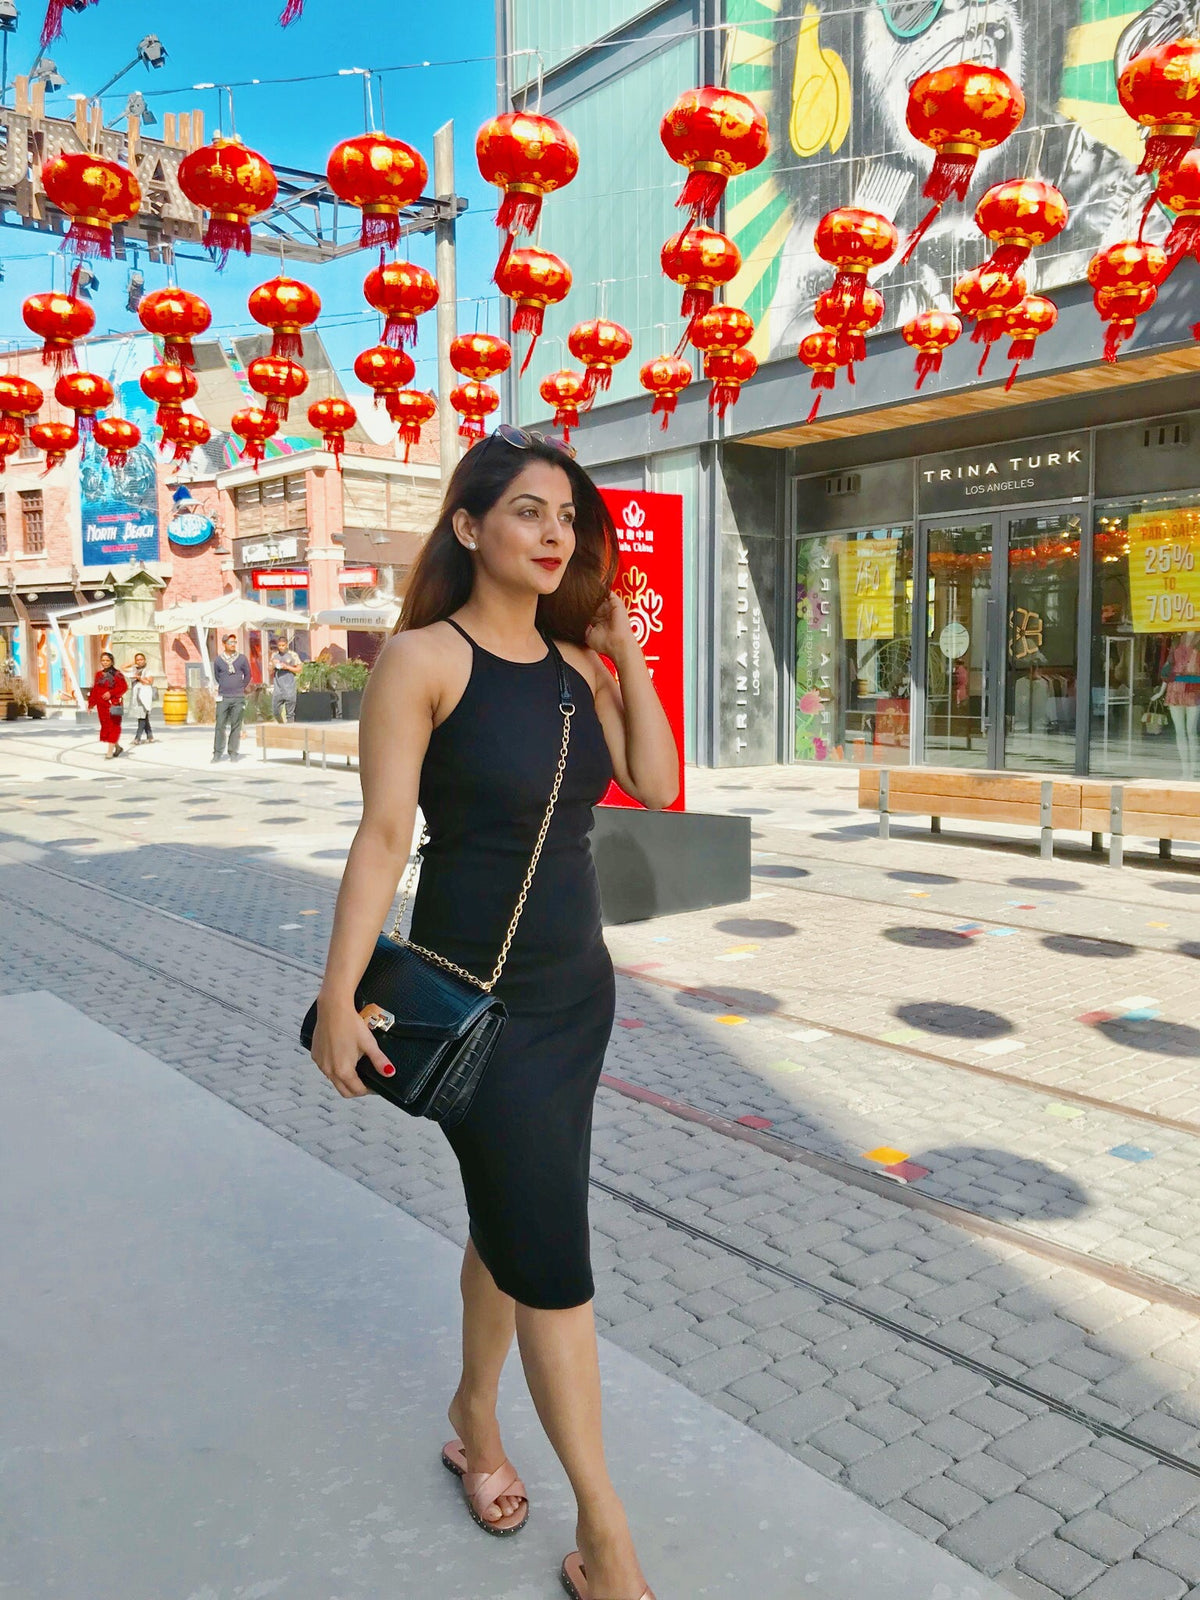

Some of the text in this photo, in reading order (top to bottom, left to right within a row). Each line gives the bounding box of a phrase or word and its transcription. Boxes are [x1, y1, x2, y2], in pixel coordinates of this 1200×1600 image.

[924, 450, 1081, 483] TRINA TURK
[965, 478, 1035, 496] LOS ANGELES
[87, 524, 118, 543] NORTH
[122, 522, 155, 542] BEACH
[1171, 522, 1199, 538] SALE
[1145, 543, 1195, 575] 25%
[1163, 577, 1176, 590] TO
[340, 615, 373, 624] Pomme
[1146, 593, 1195, 623] 70%
[736, 548, 749, 754] TRINA TURK
[752, 607, 761, 697] LOS ANGELES
